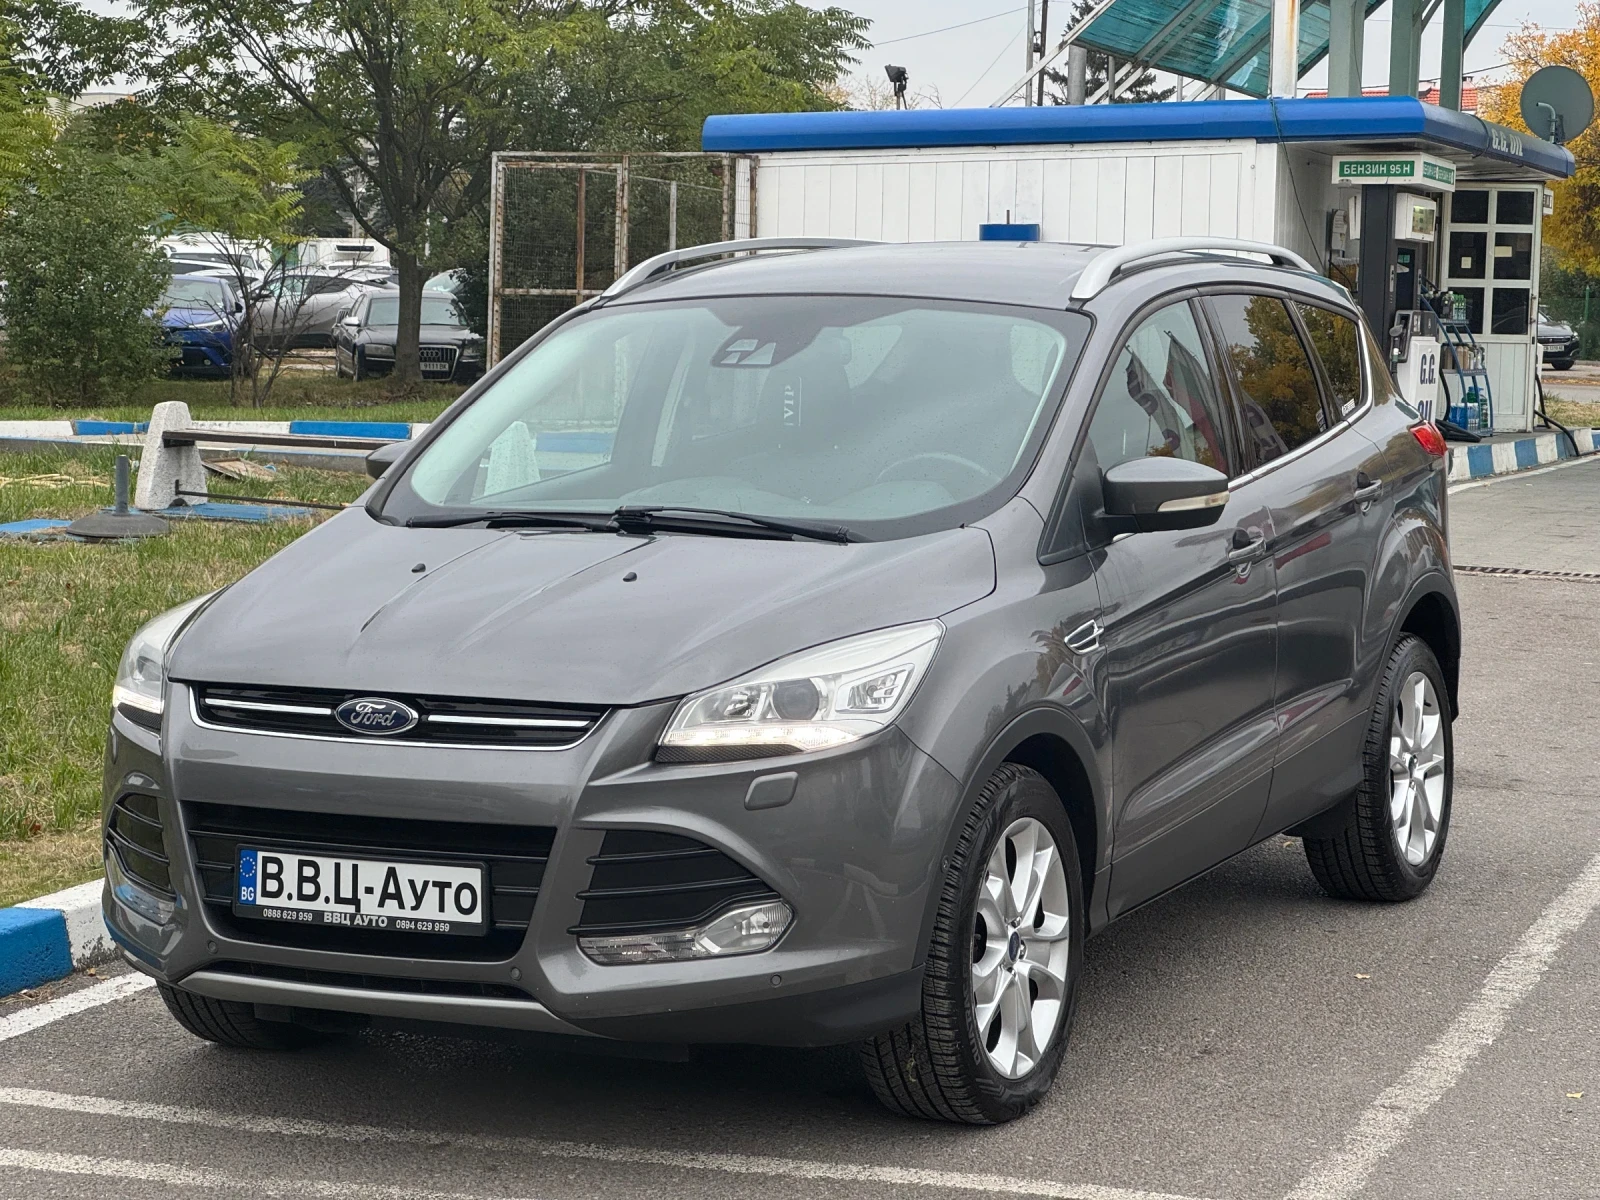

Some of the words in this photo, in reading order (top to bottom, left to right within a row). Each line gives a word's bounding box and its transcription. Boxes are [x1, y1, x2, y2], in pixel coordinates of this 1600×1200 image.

[1491, 128, 1508, 152] G.G.
[1509, 133, 1523, 156] OIL
[1343, 163, 1387, 175] БЕНЗИН
[1389, 164, 1401, 174] 95
[1420, 353, 1436, 385] G.G.
[783, 385, 794, 419] VIP
[350, 702, 397, 726] Ford
[241, 886, 255, 901] BG
[262, 908, 282, 919] 0888
[282, 910, 297, 920] 629
[323, 911, 351, 926] ВВЦ
[353, 914, 388, 928] АУТО
[416, 921, 433, 931] 629
